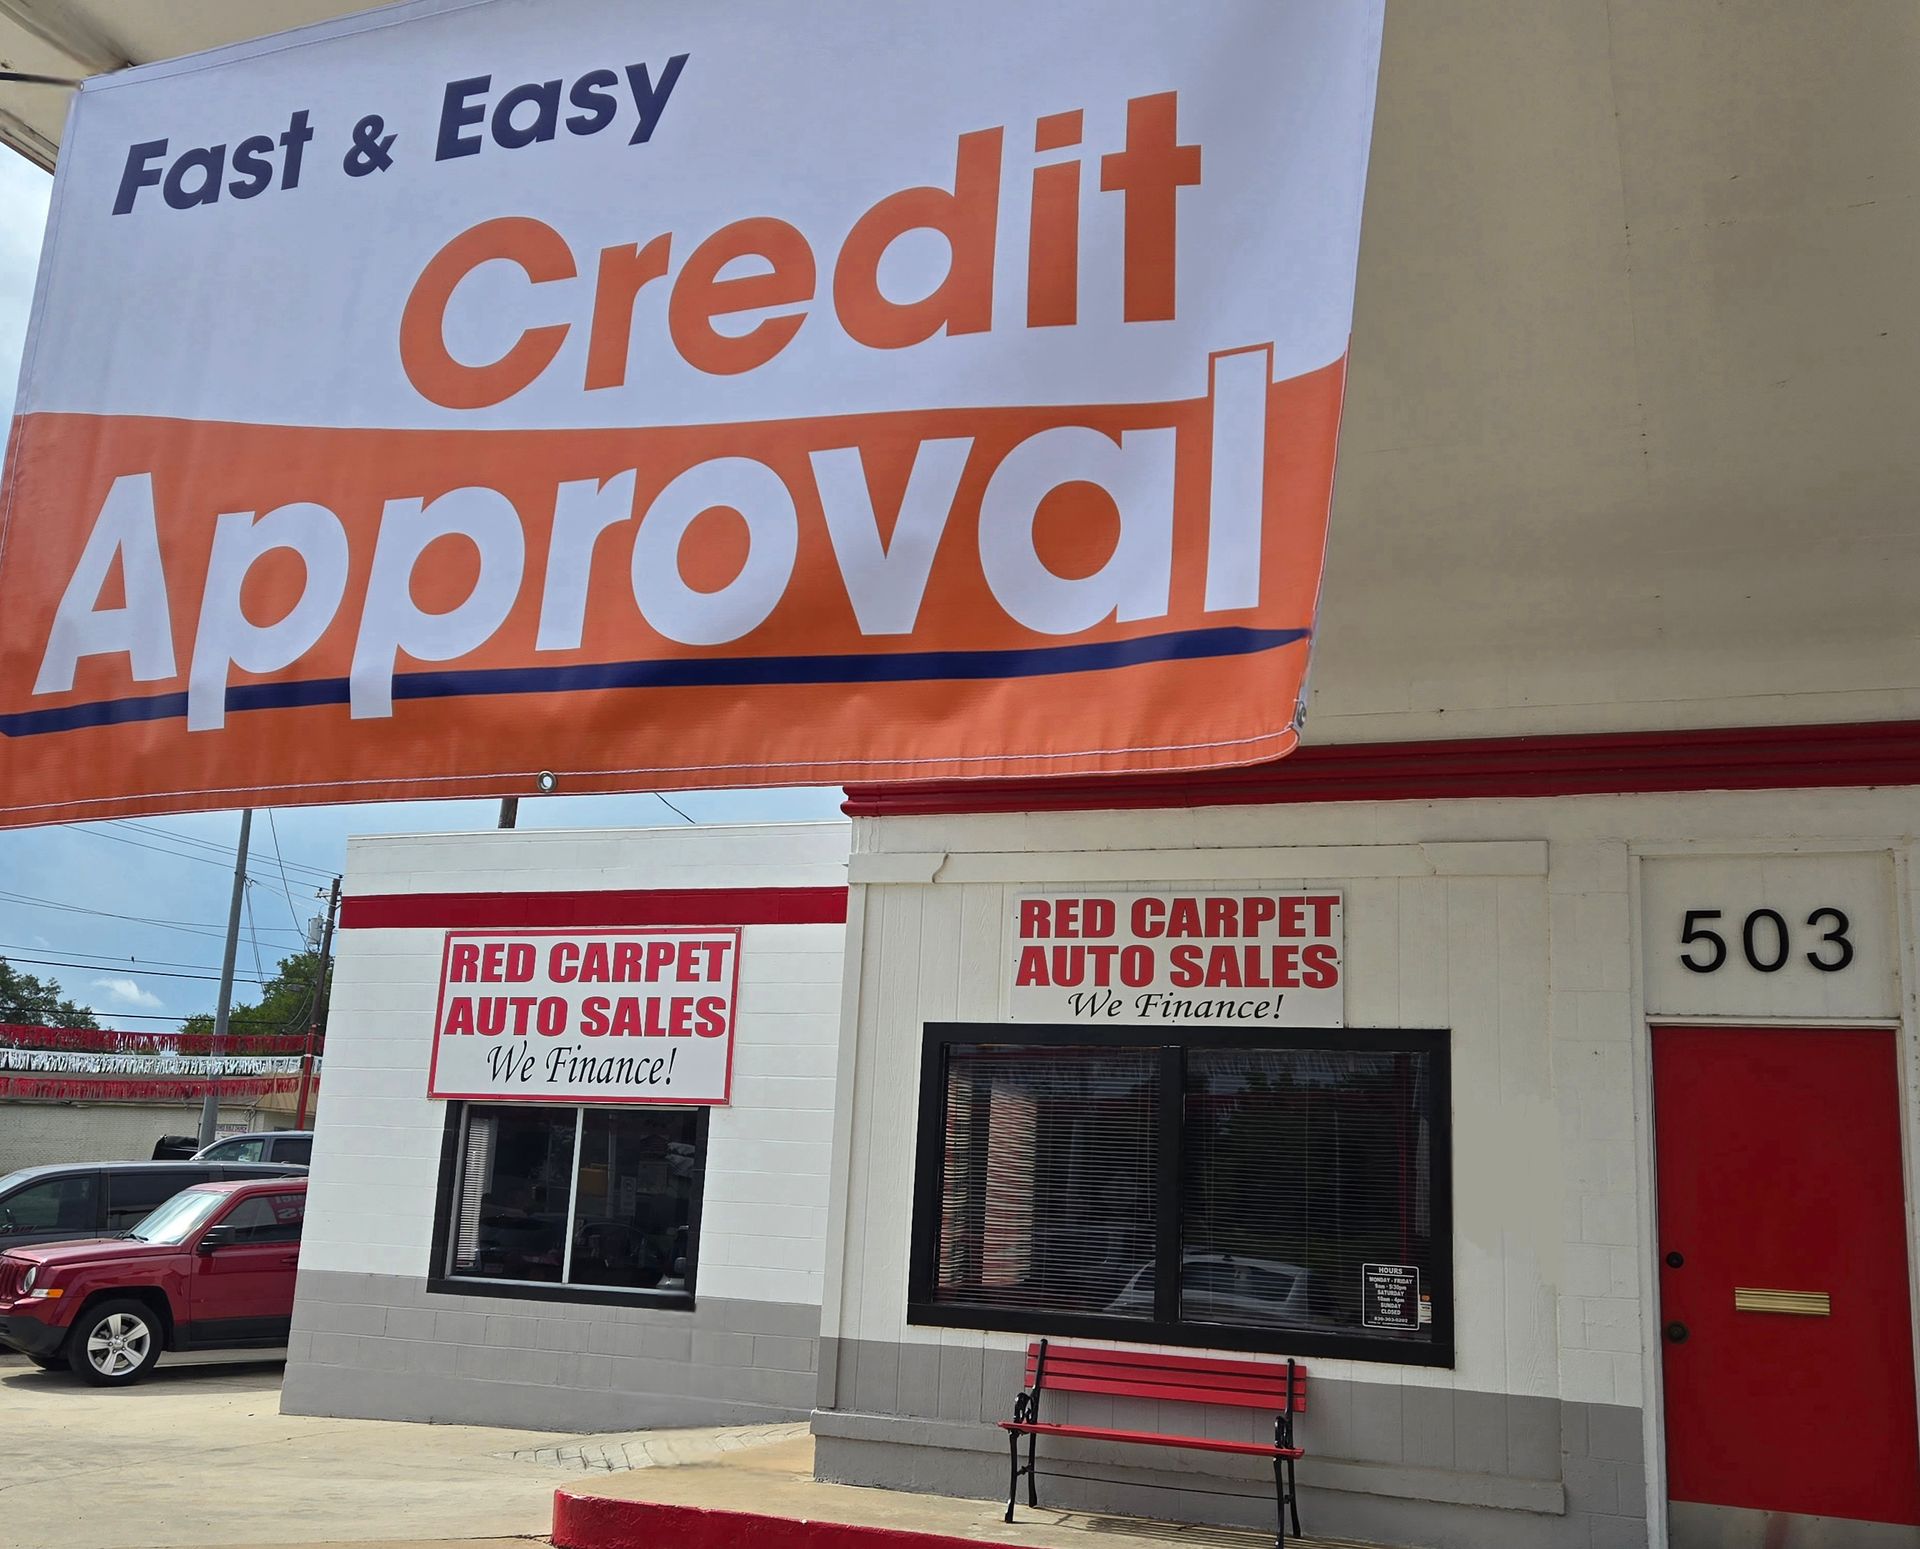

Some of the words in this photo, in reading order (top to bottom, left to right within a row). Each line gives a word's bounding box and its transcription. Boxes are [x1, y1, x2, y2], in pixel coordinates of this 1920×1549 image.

[112, 110, 313, 215] Fast
[343, 115, 397, 177] &
[435, 53, 690, 161] Easy
[399, 90, 1201, 410] Credit
[32, 345, 1271, 731] Approval
[1019, 899, 1116, 938] RED
[1131, 896, 1340, 938] CARPET
[449, 943, 537, 982] RED
[548, 941, 732, 983] CARPET
[1680, 907, 1854, 973] 503
[1015, 945, 1155, 988] AUTO
[1169, 944, 1339, 989] SALES
[443, 996, 568, 1036] AUTO
[580, 996, 727, 1038] SALES
[1068, 989, 1123, 1017] We
[1135, 992, 1284, 1019] Finance!
[487, 1040, 535, 1083] We
[545, 1044, 678, 1085] Finance!
[1379, 1267, 1403, 1275] HOURS
